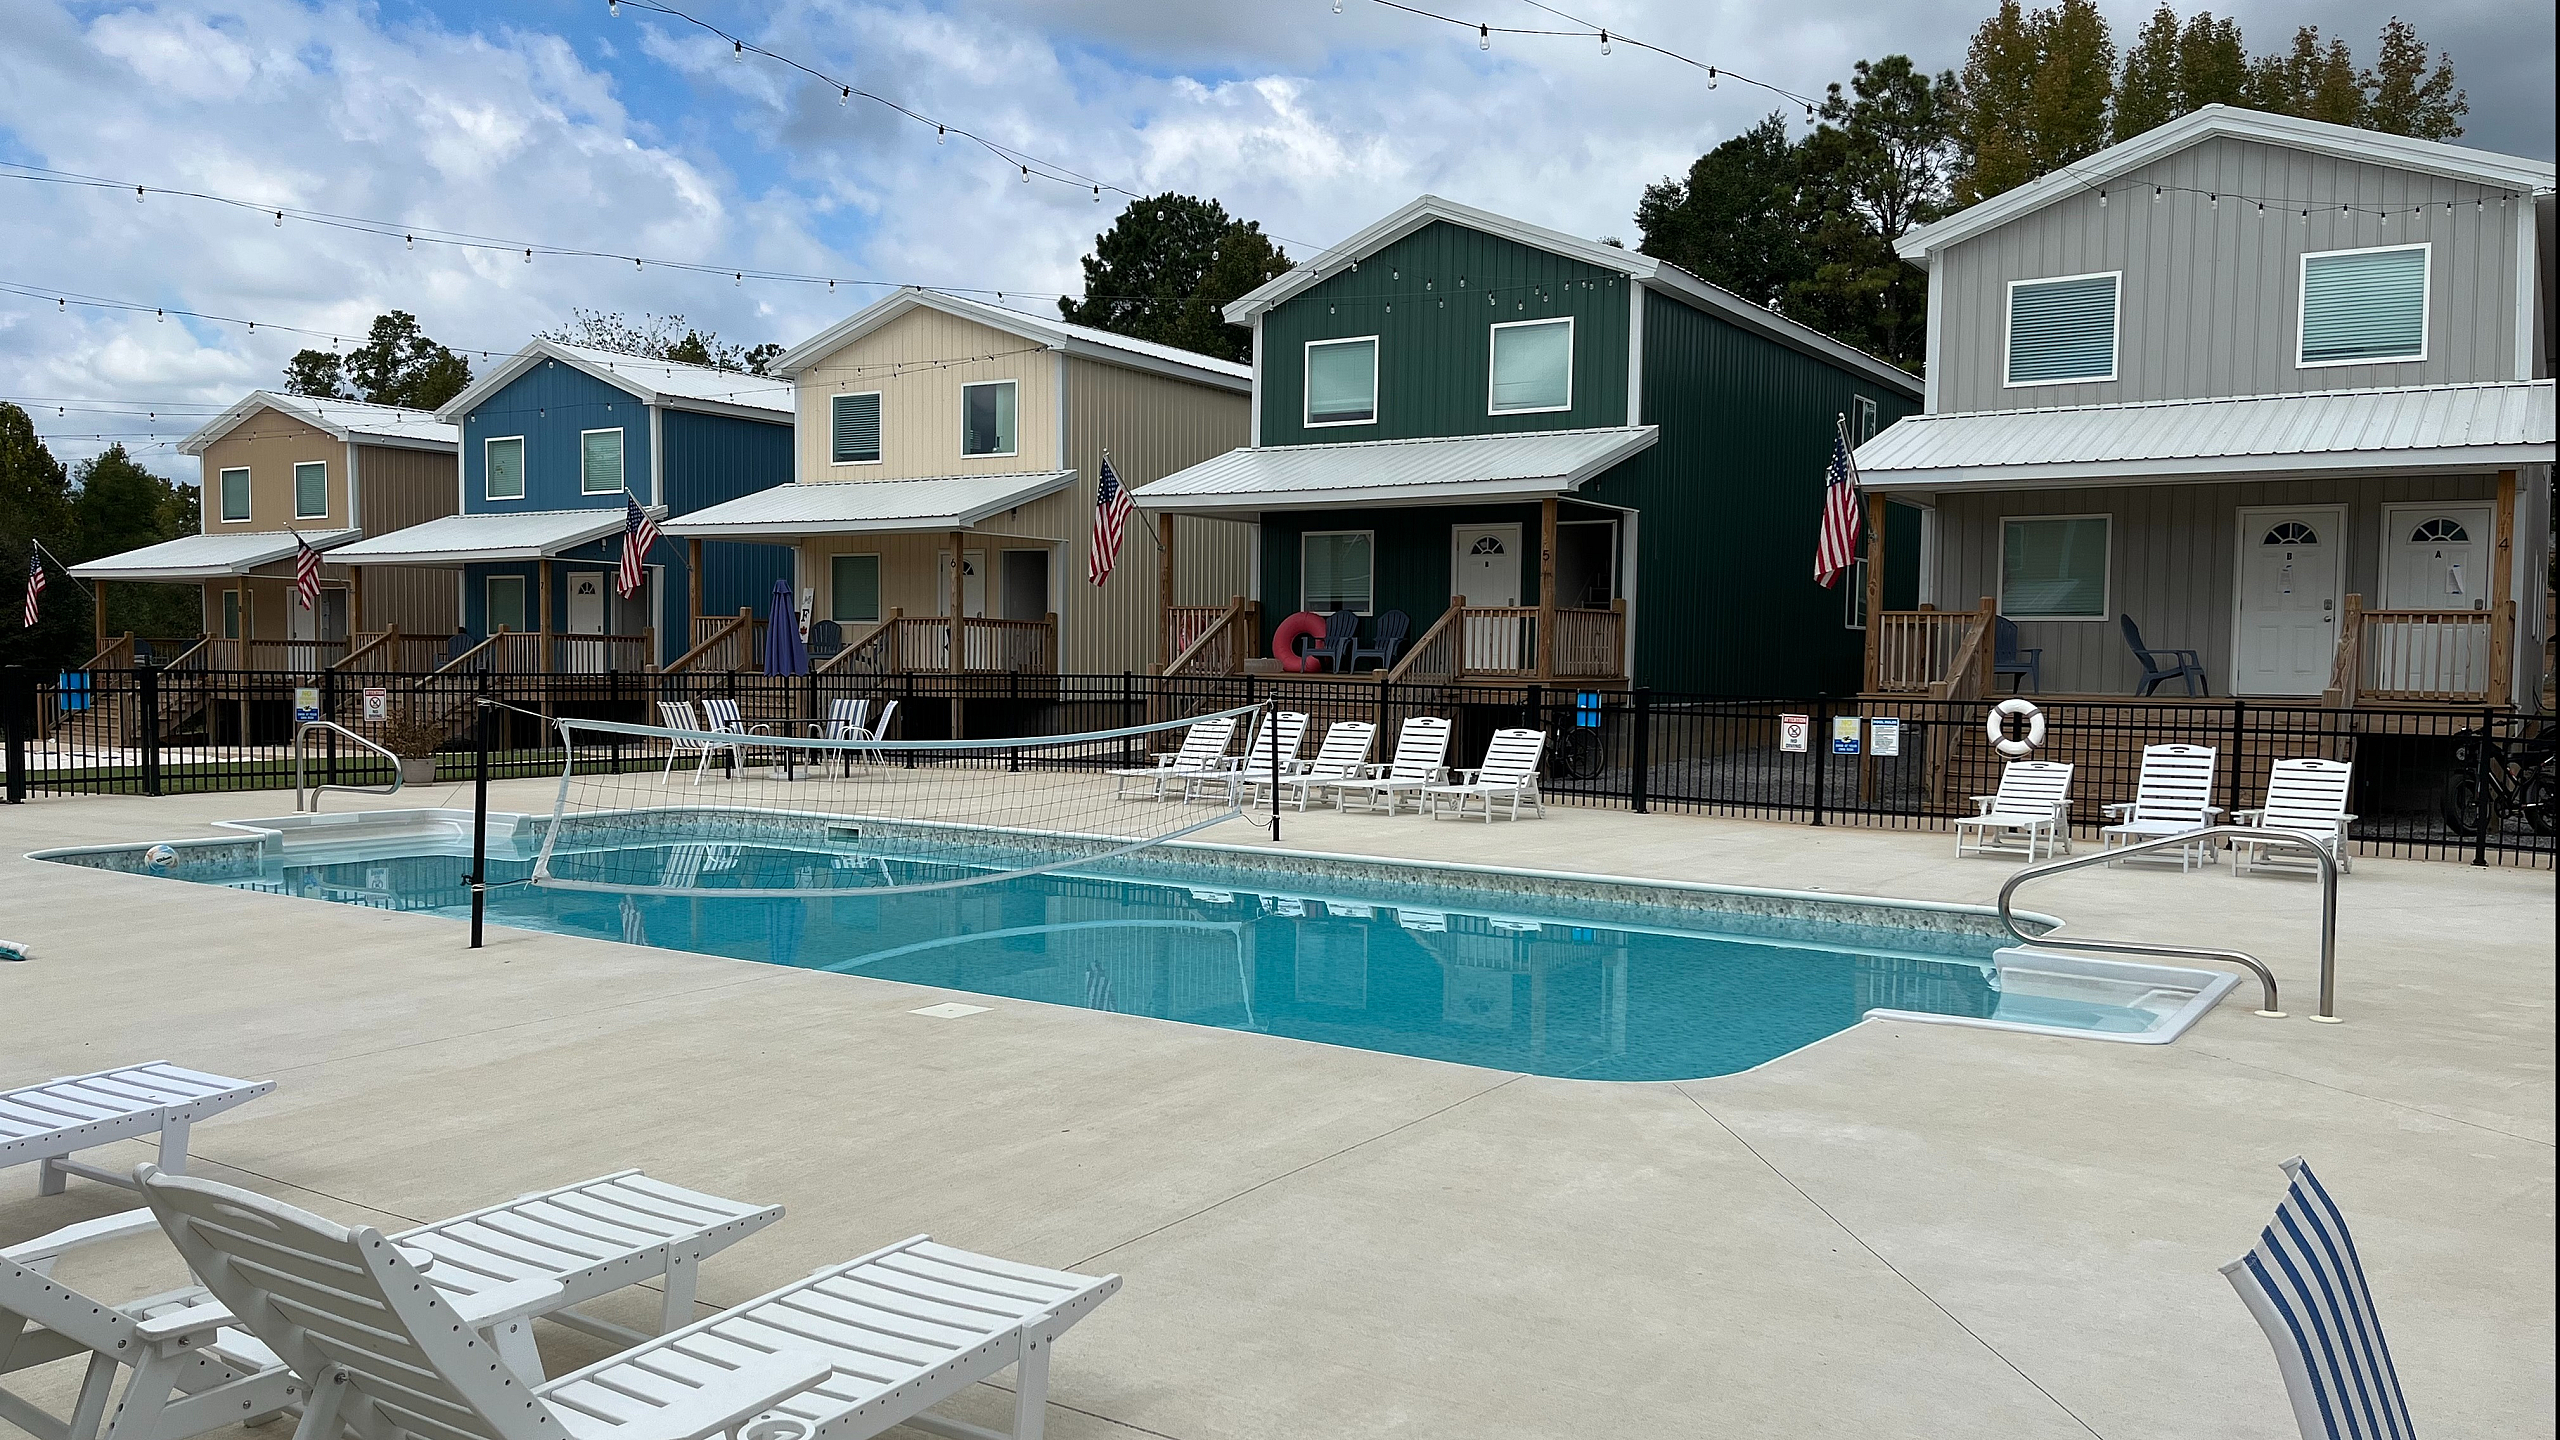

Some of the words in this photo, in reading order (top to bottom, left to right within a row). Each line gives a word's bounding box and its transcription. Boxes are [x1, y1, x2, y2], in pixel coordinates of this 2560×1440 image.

[2498, 537, 2510, 551] 4
[1542, 550, 1550, 561] 5
[2286, 552, 2293, 561] B
[2434, 550, 2442, 559] A
[950, 558, 957, 568] 6
